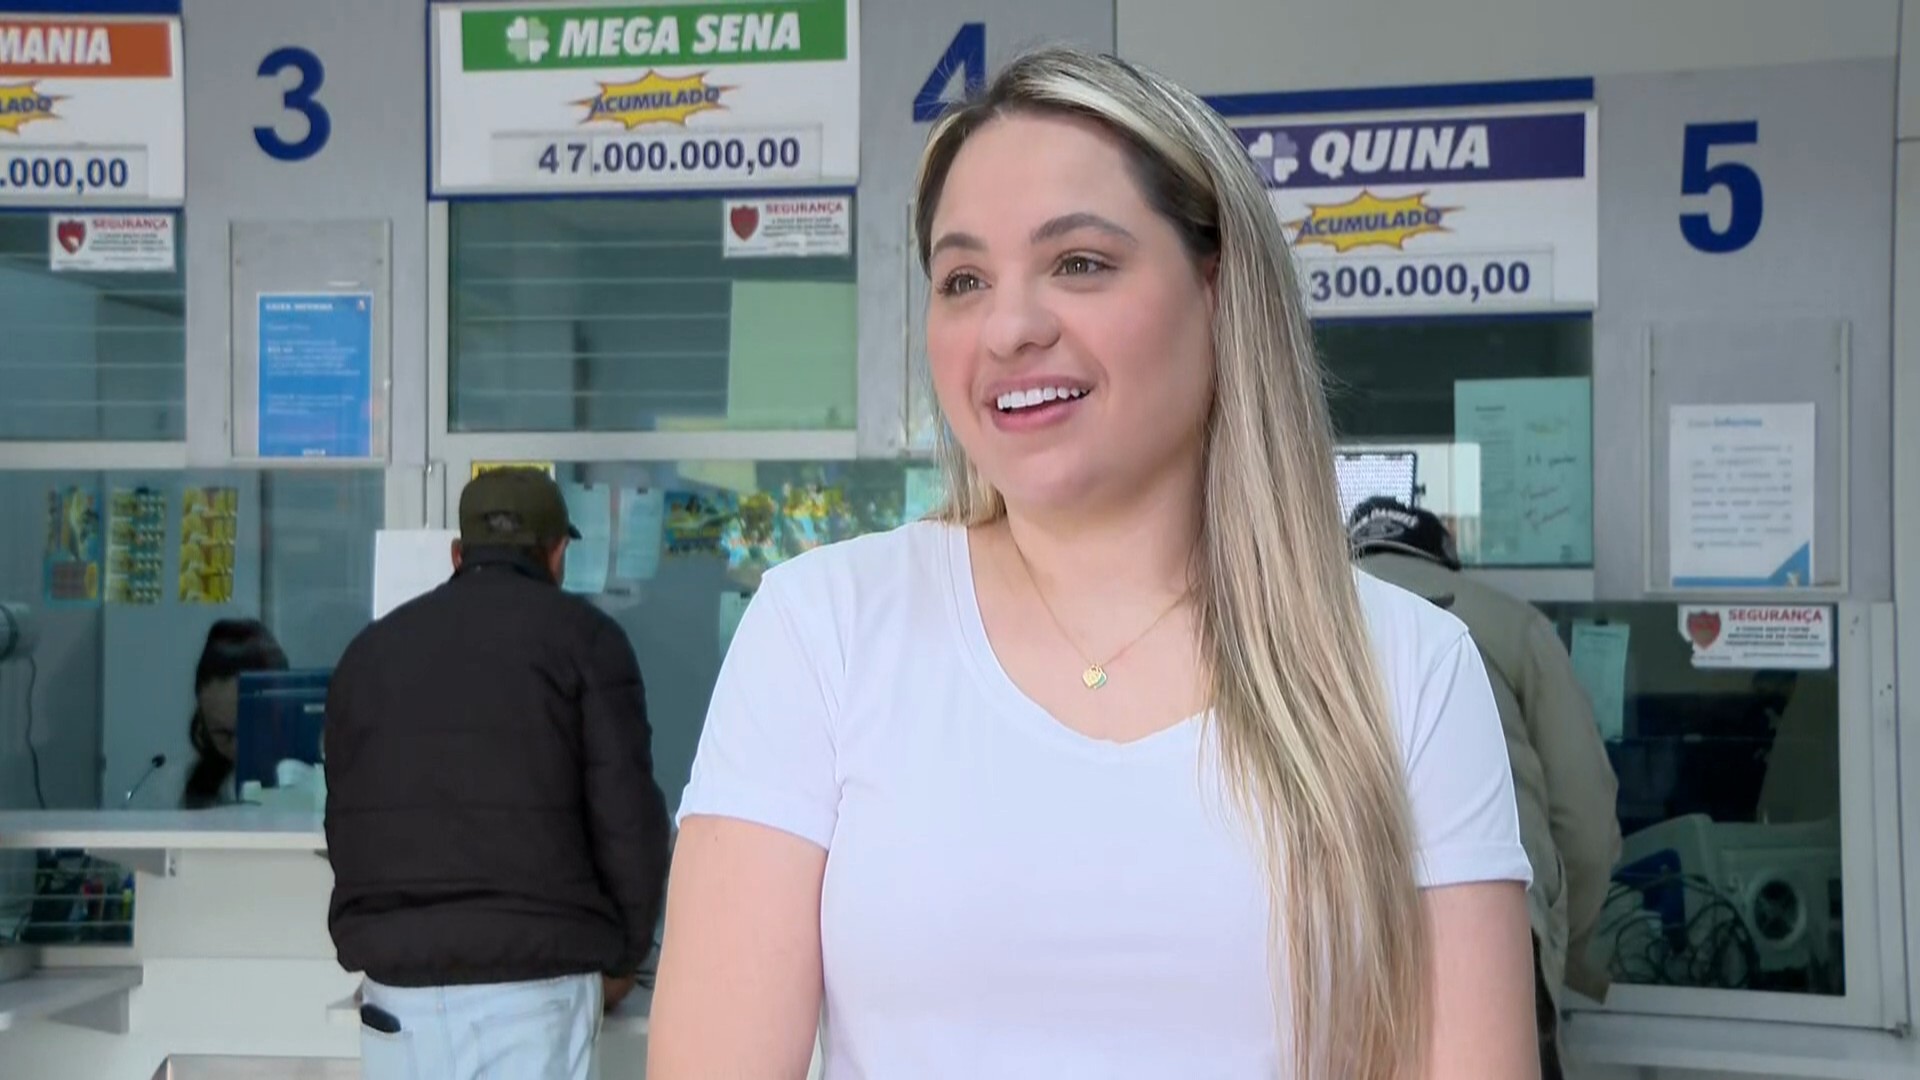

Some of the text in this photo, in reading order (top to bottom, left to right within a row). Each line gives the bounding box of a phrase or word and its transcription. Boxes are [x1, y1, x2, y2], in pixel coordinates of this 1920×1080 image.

[558, 12, 801, 58] MEGA SENA
[253, 46, 331, 161] 3
[591, 86, 720, 115] ACUMULADO
[538, 137, 801, 175] 47.000.000,00
[1310, 124, 1490, 179] QUINA
[1679, 120, 1764, 253] 5
[765, 202, 844, 214] SEGURANÇA
[1298, 208, 1442, 238] ACUMULADO
[1728, 608, 1823, 623] SEGURANÇA
